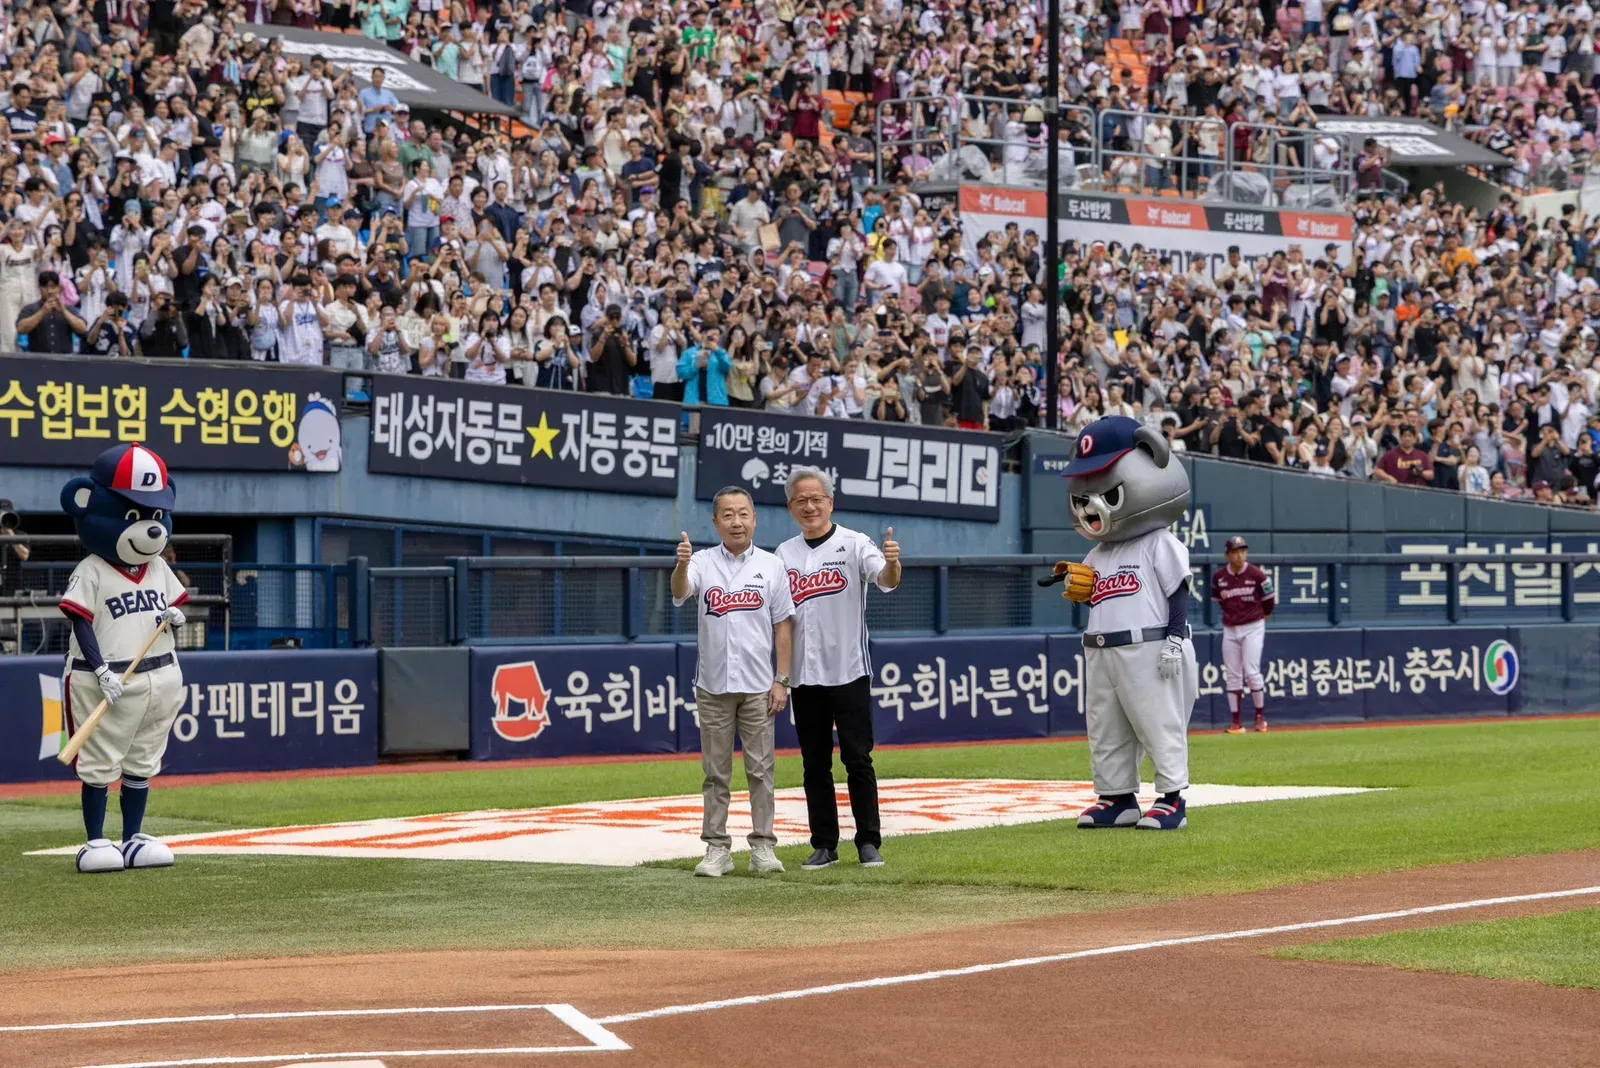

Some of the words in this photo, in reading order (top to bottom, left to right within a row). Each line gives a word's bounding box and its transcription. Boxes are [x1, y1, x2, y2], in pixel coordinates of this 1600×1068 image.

[993, 195, 1027, 213] Bobcat
[1068, 199, 1112, 221] 두산밥캣
[1160, 207, 1192, 227] Bobcat
[1223, 211, 1265, 232] 두산밥캣
[1310, 221, 1339, 238] Bobcat
[0, 380, 147, 442] 수협보험
[160, 387, 296, 448] 수협은행
[374, 392, 525, 465] 태성자동문
[559, 409, 678, 478] 자동중문
[756, 426, 790, 455] 원의
[792, 430, 829, 458] 기적
[1080, 435, 1094, 458] D
[141, 472, 156, 487] D
[841, 432, 999, 507] 그린리더
[704, 586, 764, 618] Bears
[787, 568, 848, 607] Bears
[1403, 645, 1481, 695] 충주시
[870, 653, 1084, 722] 육회바른연어
